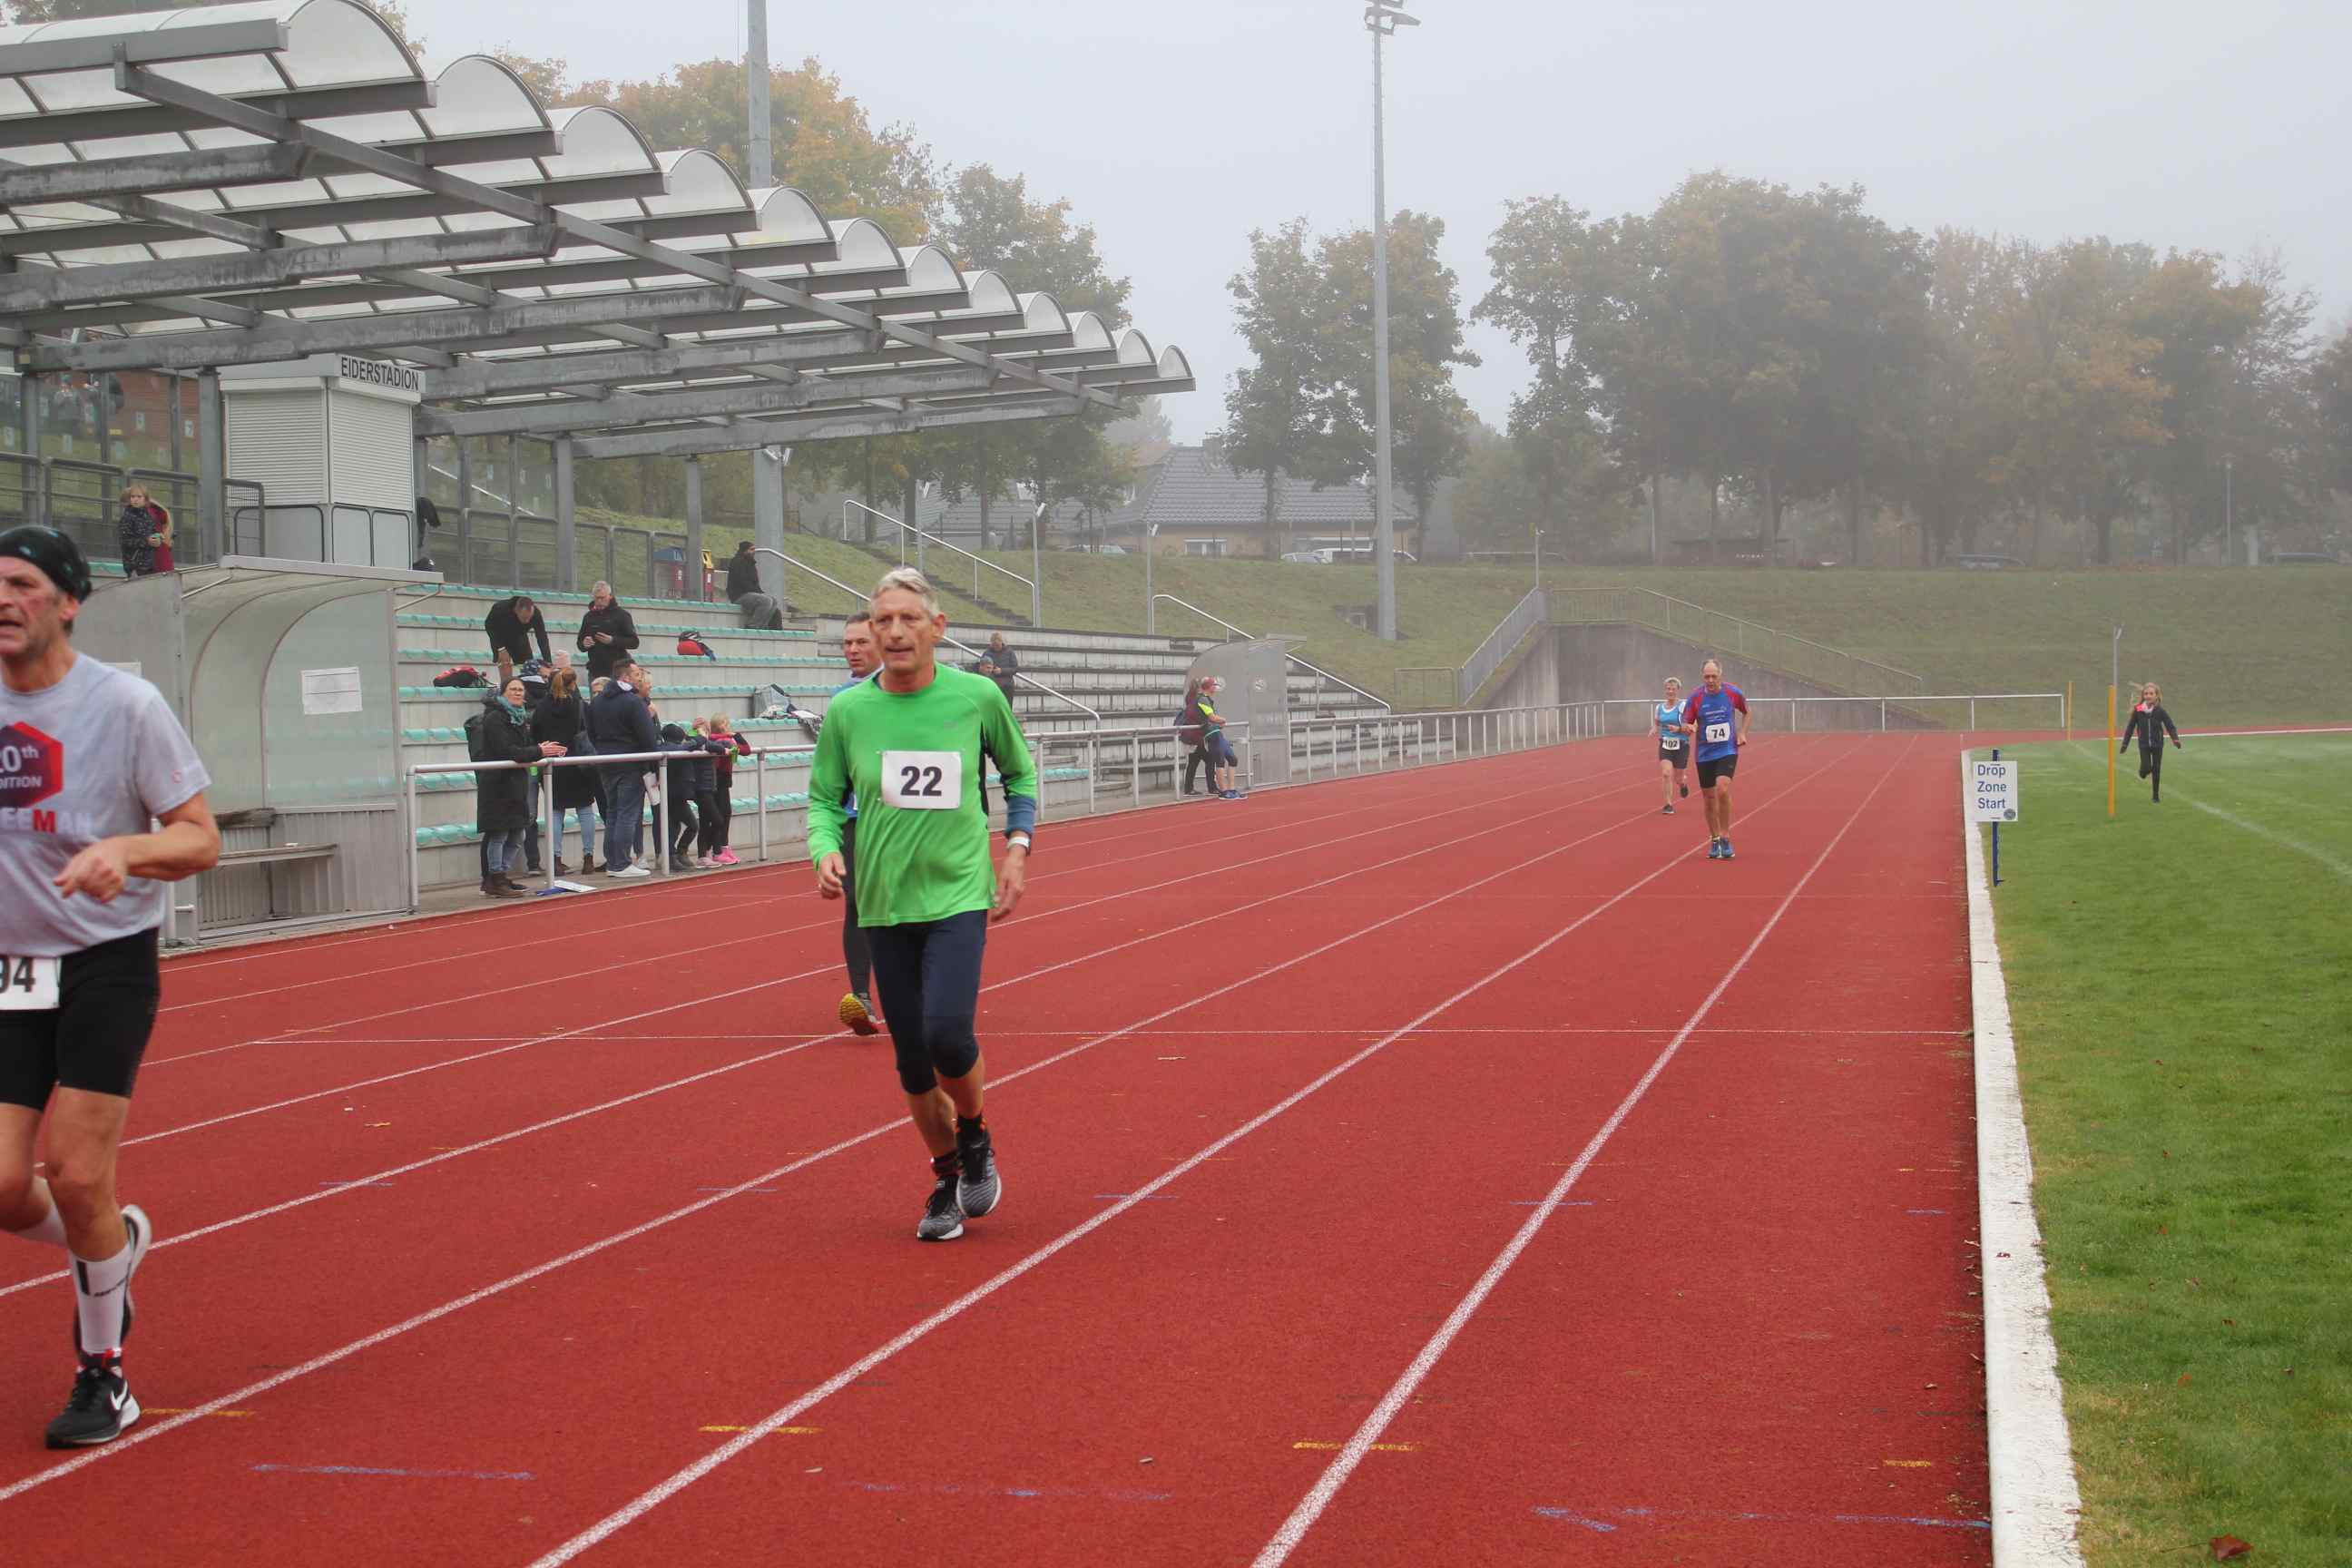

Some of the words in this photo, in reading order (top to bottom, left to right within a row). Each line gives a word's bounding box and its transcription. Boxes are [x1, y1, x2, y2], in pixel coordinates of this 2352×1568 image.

[341, 356, 418, 391] EIDERSTADION
[1710, 729, 1726, 740] 74
[1977, 764, 2006, 779] Drop
[900, 765, 943, 797] 22
[1977, 780, 2007, 792] Zone
[1978, 797, 2005, 809] Start
